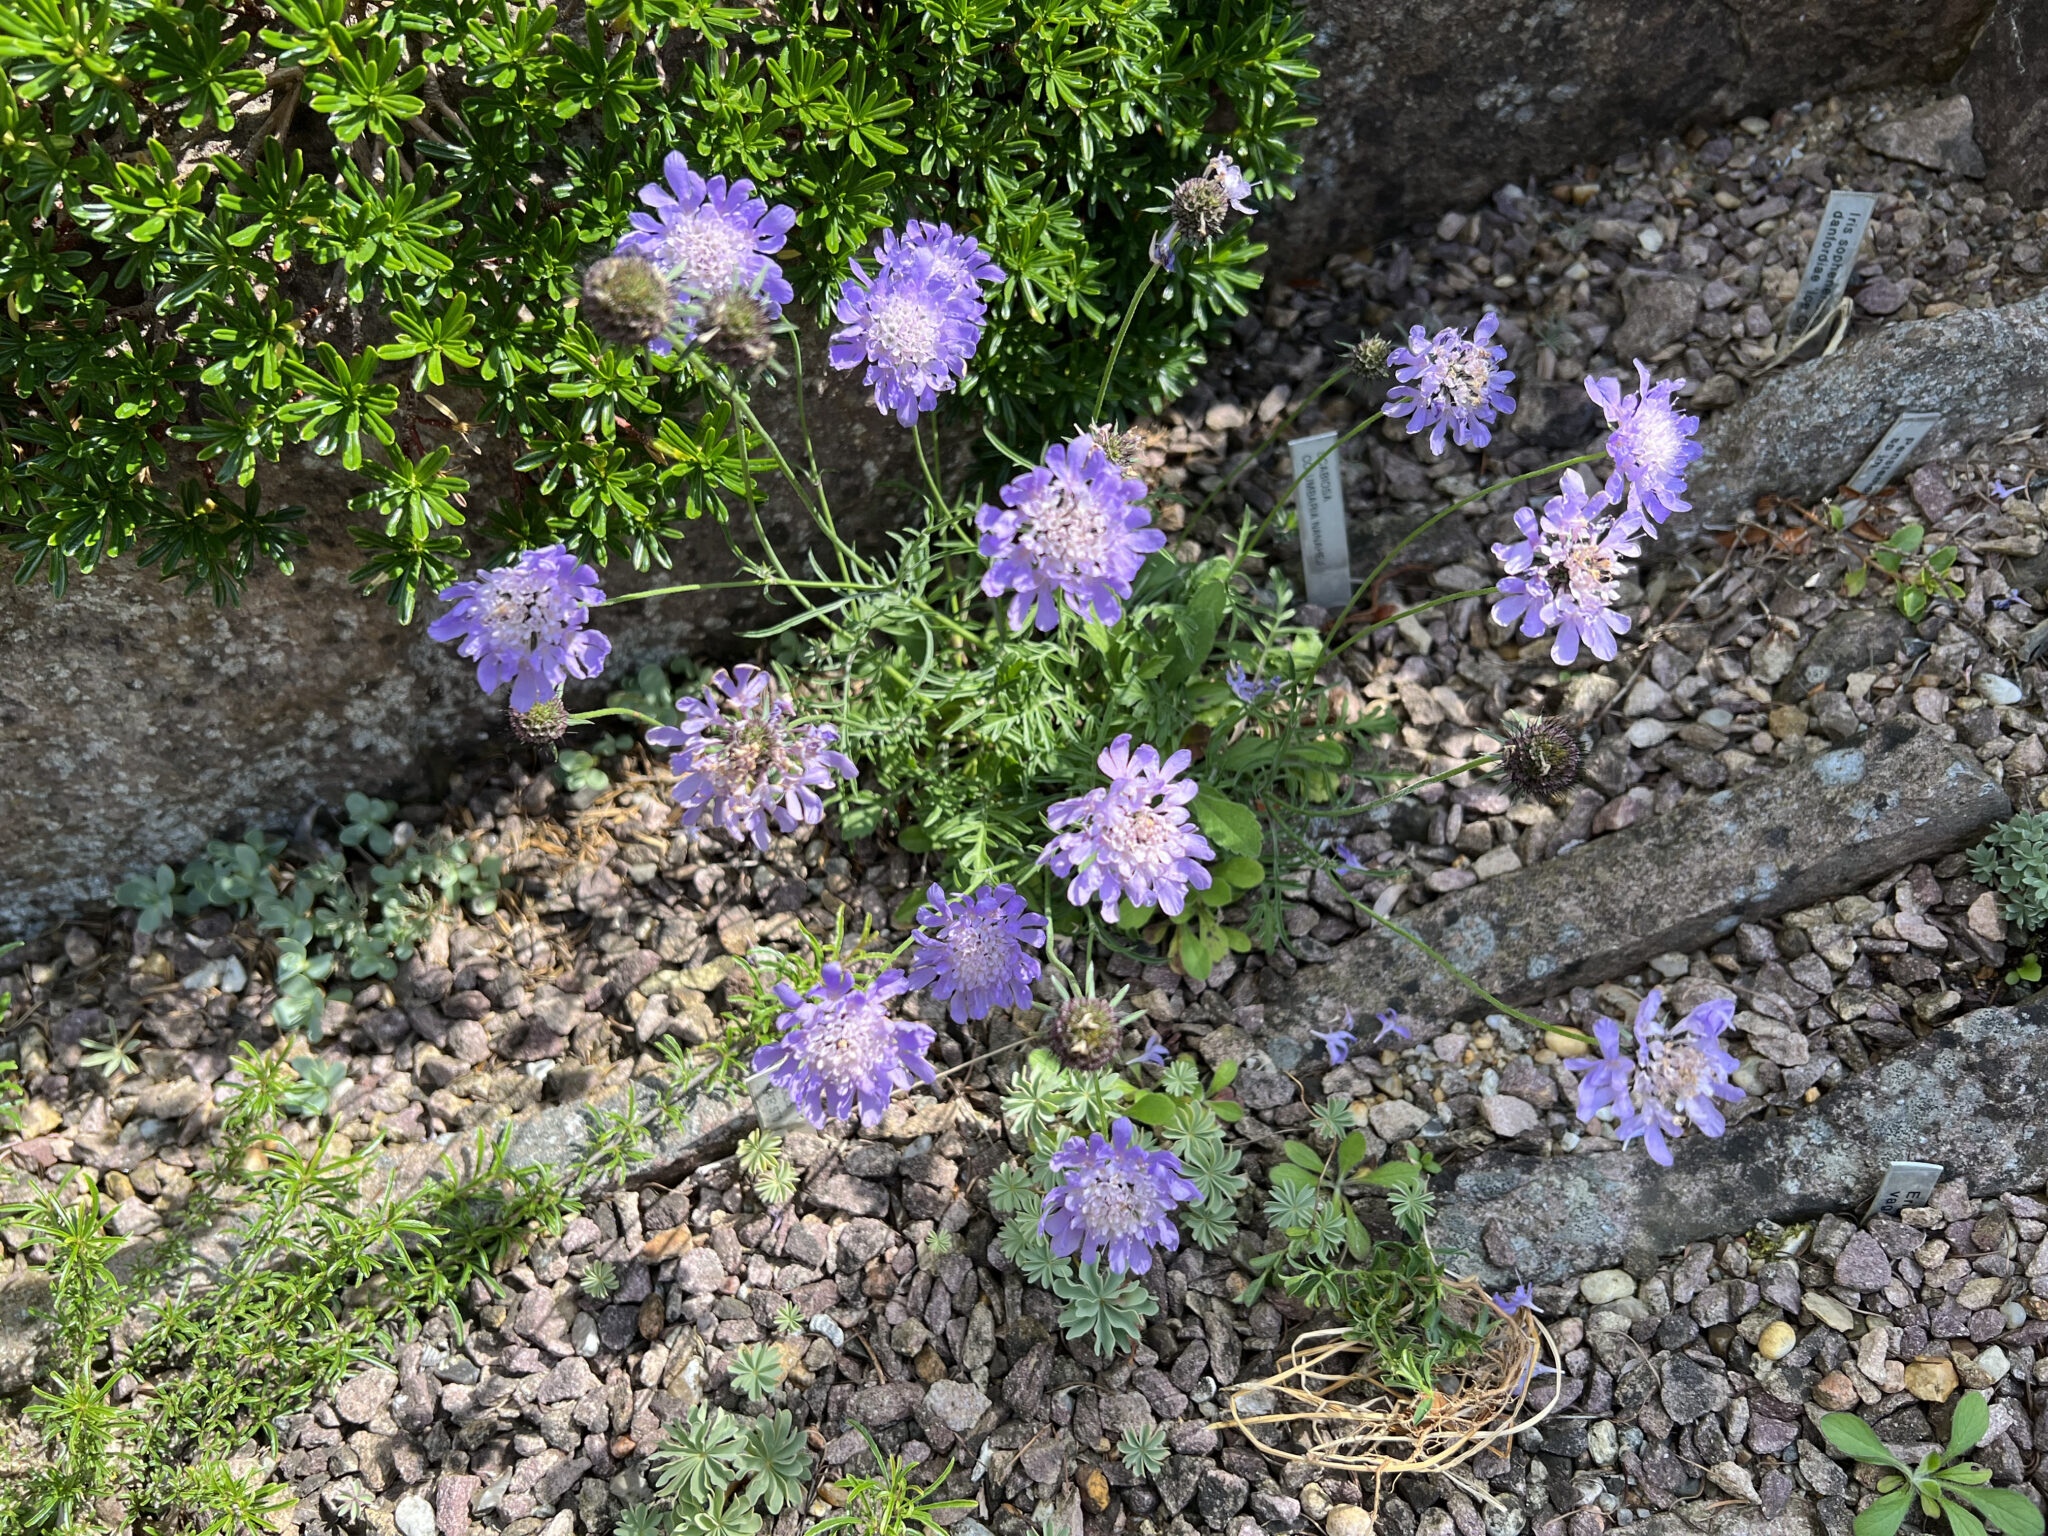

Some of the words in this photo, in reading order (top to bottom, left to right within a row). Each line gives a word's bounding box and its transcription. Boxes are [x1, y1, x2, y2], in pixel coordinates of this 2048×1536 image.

[1810, 211, 1844, 282] danfordiae
[1843, 212, 1861, 234] Iris
[1819, 240, 1849, 302] sophene
[1302, 455, 1319, 520] COUMBARIA
[1863, 437, 1915, 493] Penstemo
[1880, 1191, 1901, 1213] vag
